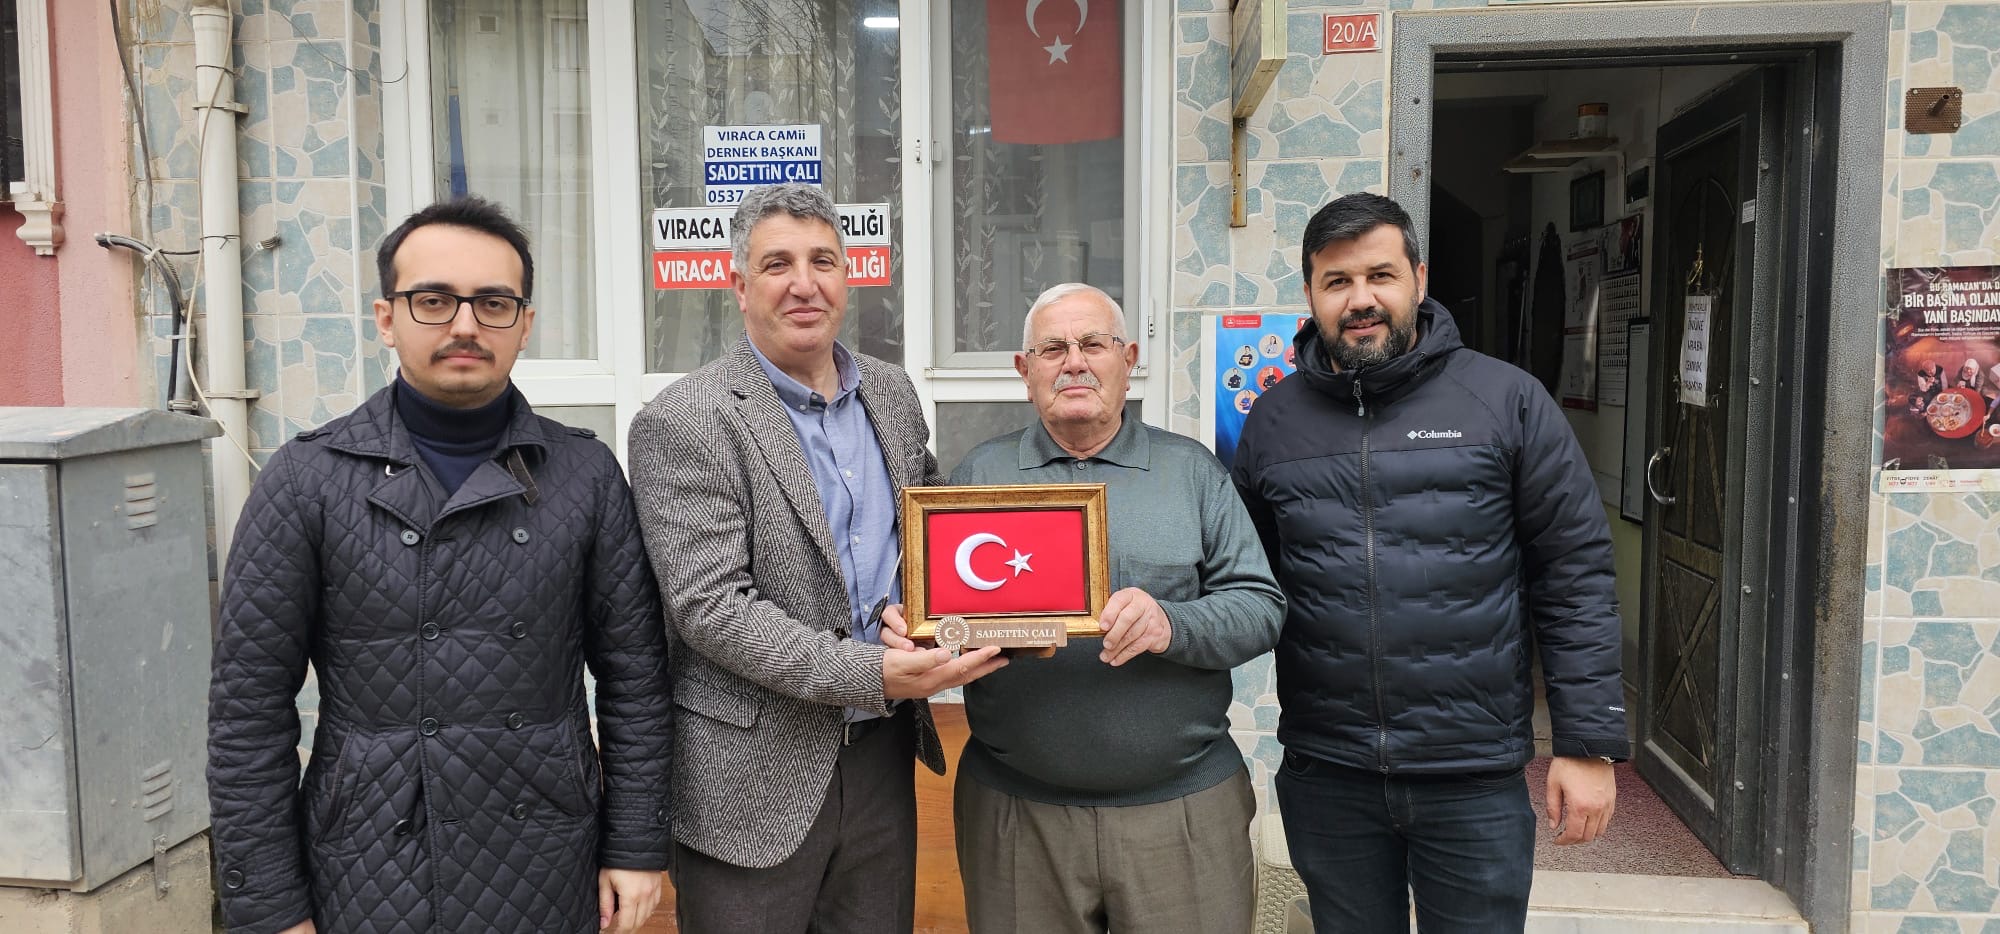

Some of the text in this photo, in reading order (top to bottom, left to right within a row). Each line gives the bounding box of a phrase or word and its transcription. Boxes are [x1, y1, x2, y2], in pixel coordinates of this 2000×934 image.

[1331, 20, 1377, 44] 20/A
[718, 130, 765, 141] VIRACA
[707, 146, 817, 159] DERNEK BAŞKANI
[785, 163, 819, 182] ÇALI
[708, 190, 744, 203] 0537
[658, 217, 725, 240] VIRACA
[840, 209, 884, 236] RLIĞI
[657, 259, 726, 283] VIRACA
[1904, 291, 2000, 311] BİR BAŞINA OLAN
[1950, 308, 2000, 326] BAŞINDAY
[1417, 429, 1462, 439] Columbia
[976, 628, 1056, 640] SADETTİN ÇALI
